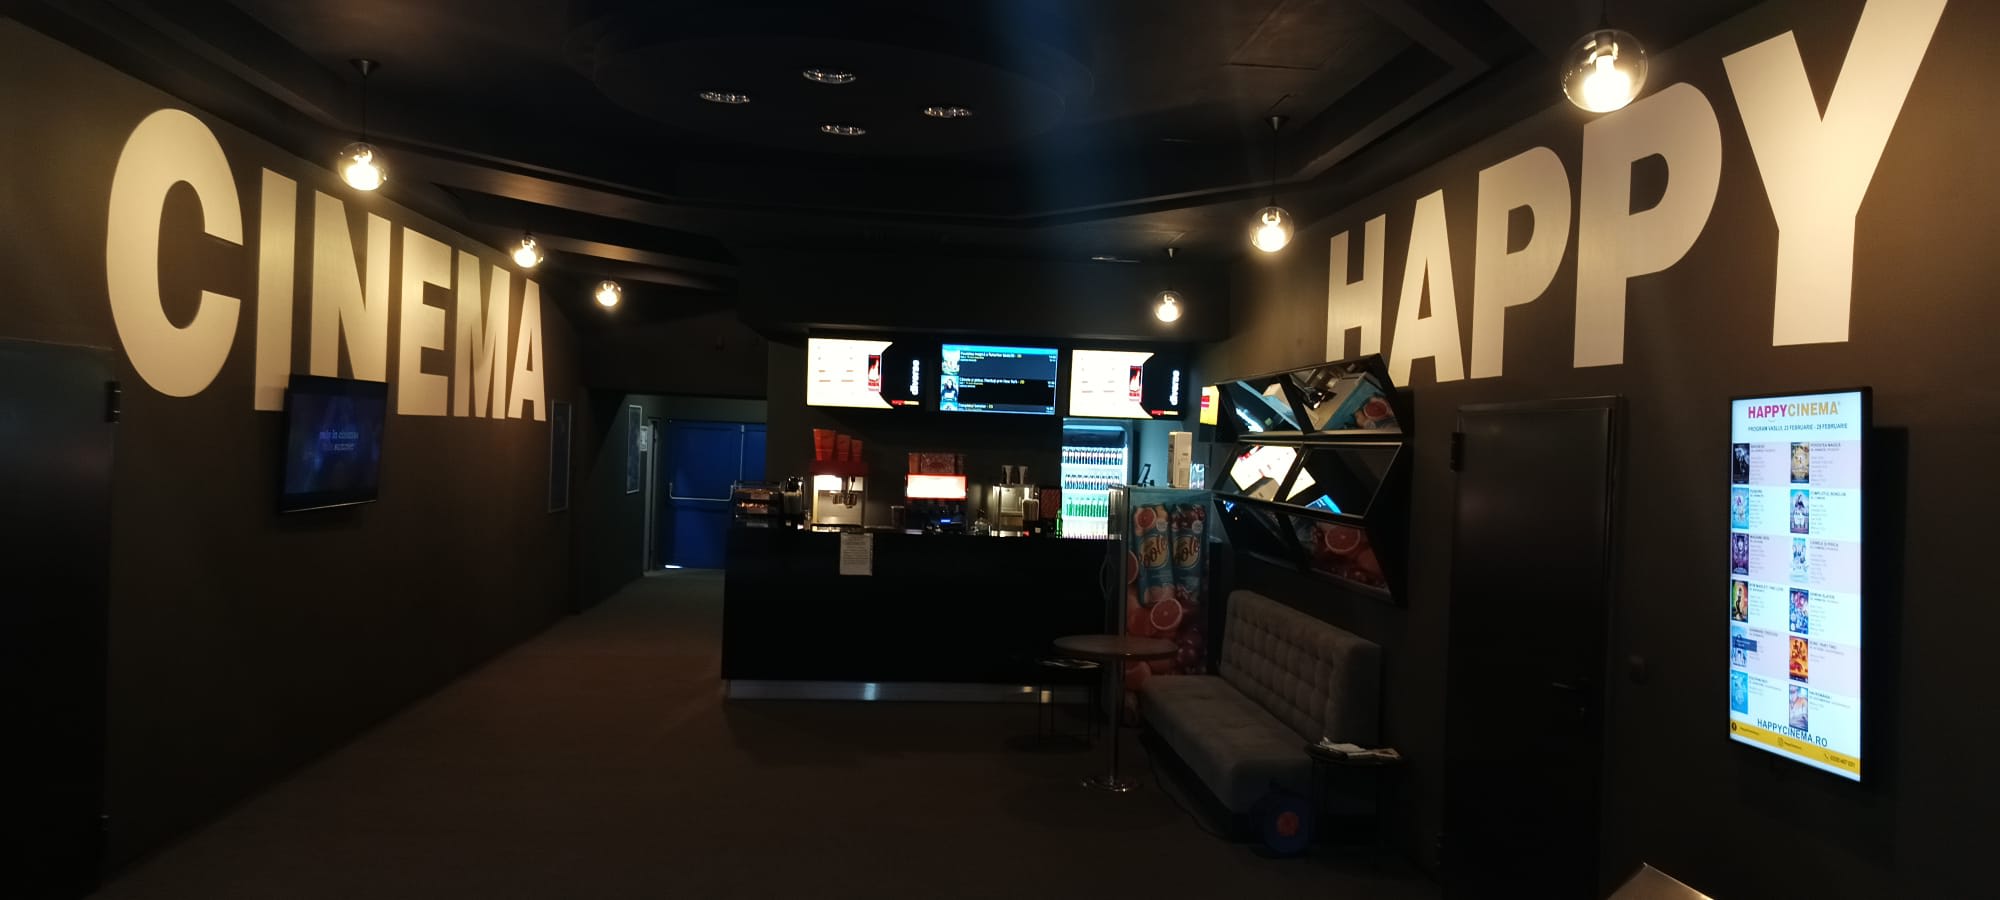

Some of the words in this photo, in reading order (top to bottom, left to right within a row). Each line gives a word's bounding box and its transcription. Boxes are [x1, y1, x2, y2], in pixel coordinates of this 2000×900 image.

[106, 108, 546, 421] CINEMA
[1326, 0, 1947, 386] HAPPY
[1757, 719, 1828, 747] HAPPYCINEMA.RO
